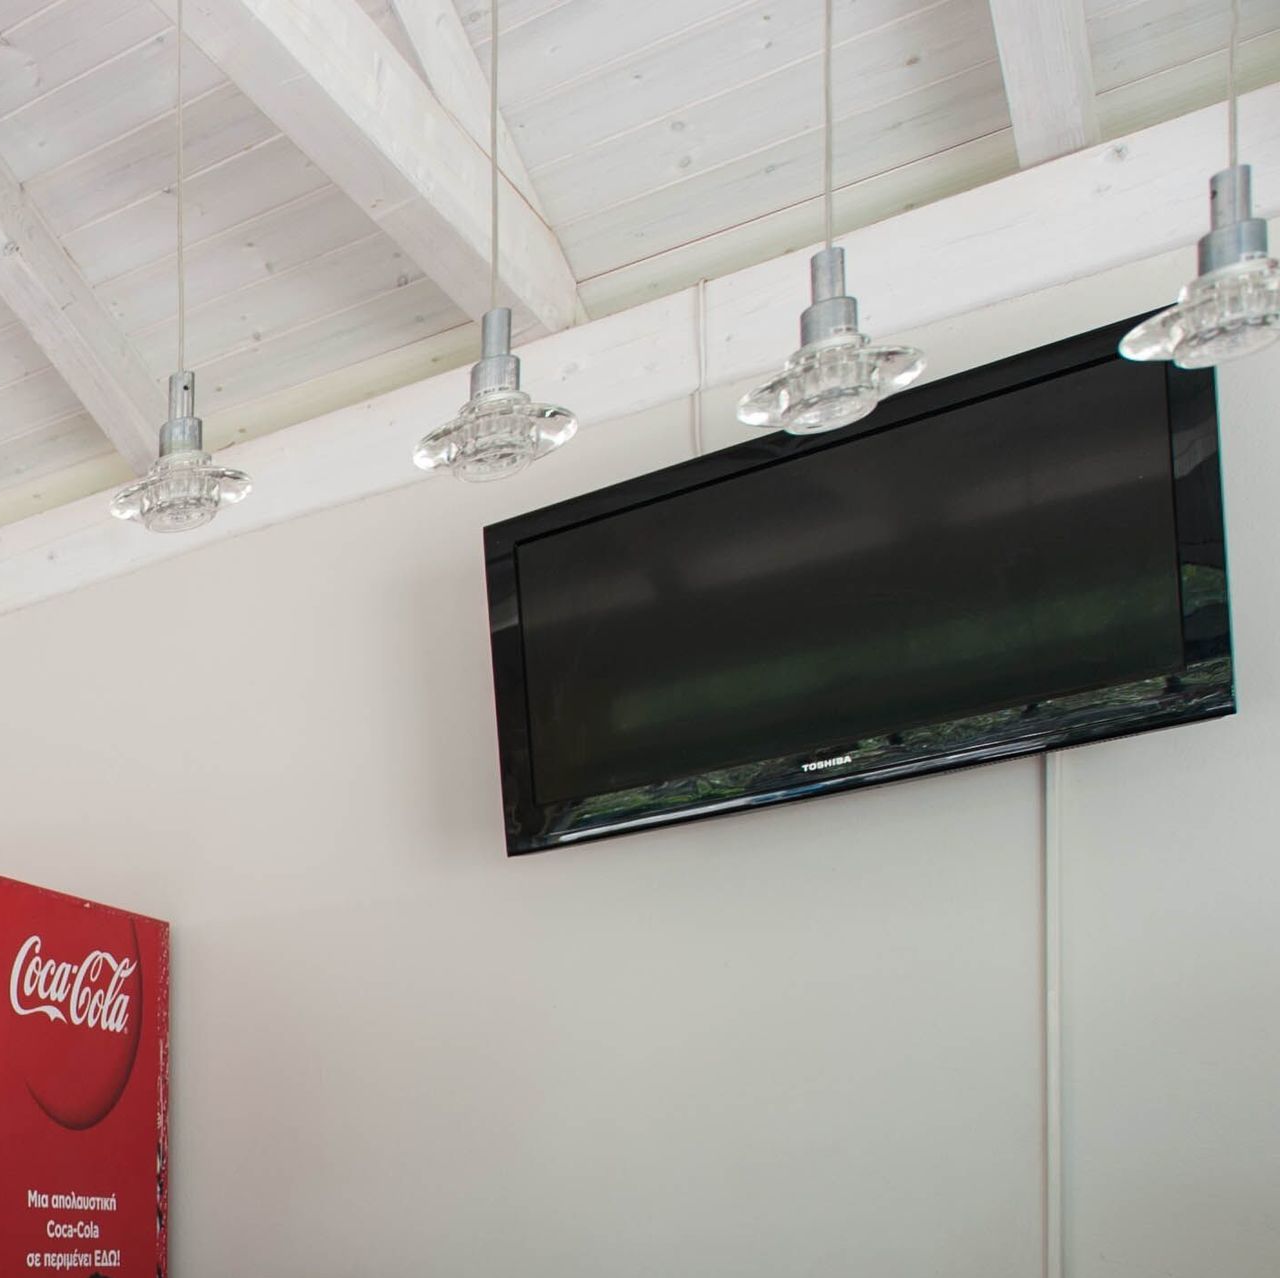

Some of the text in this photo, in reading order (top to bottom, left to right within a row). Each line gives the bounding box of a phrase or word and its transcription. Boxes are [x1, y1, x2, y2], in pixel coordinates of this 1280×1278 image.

[801, 755, 852, 772] TOSHIBA
[10, 935, 138, 1033] Coca-Cola
[27, 1190, 117, 1211] Μια απολαυστική
[46, 1220, 100, 1239] Coca-Cola
[26, 1248, 121, 1271] σε περιμένει ΕΔΩ!
